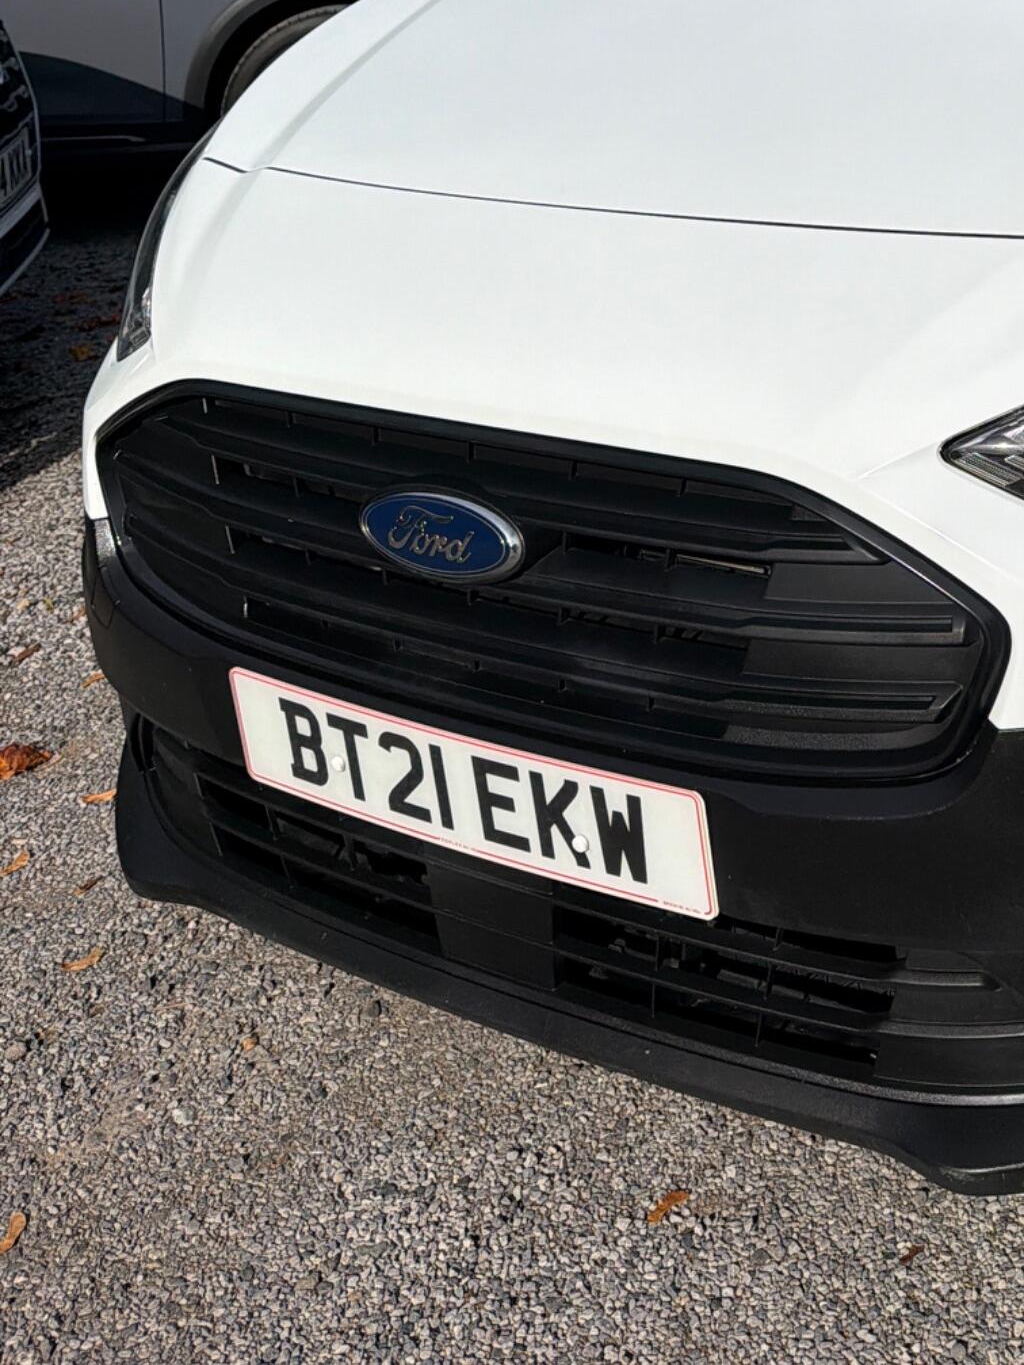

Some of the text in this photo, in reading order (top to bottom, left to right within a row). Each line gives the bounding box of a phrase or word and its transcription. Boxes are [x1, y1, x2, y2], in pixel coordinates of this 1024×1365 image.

[387, 503, 476, 565] Ford
[279, 696, 648, 885] BT21 EKW
